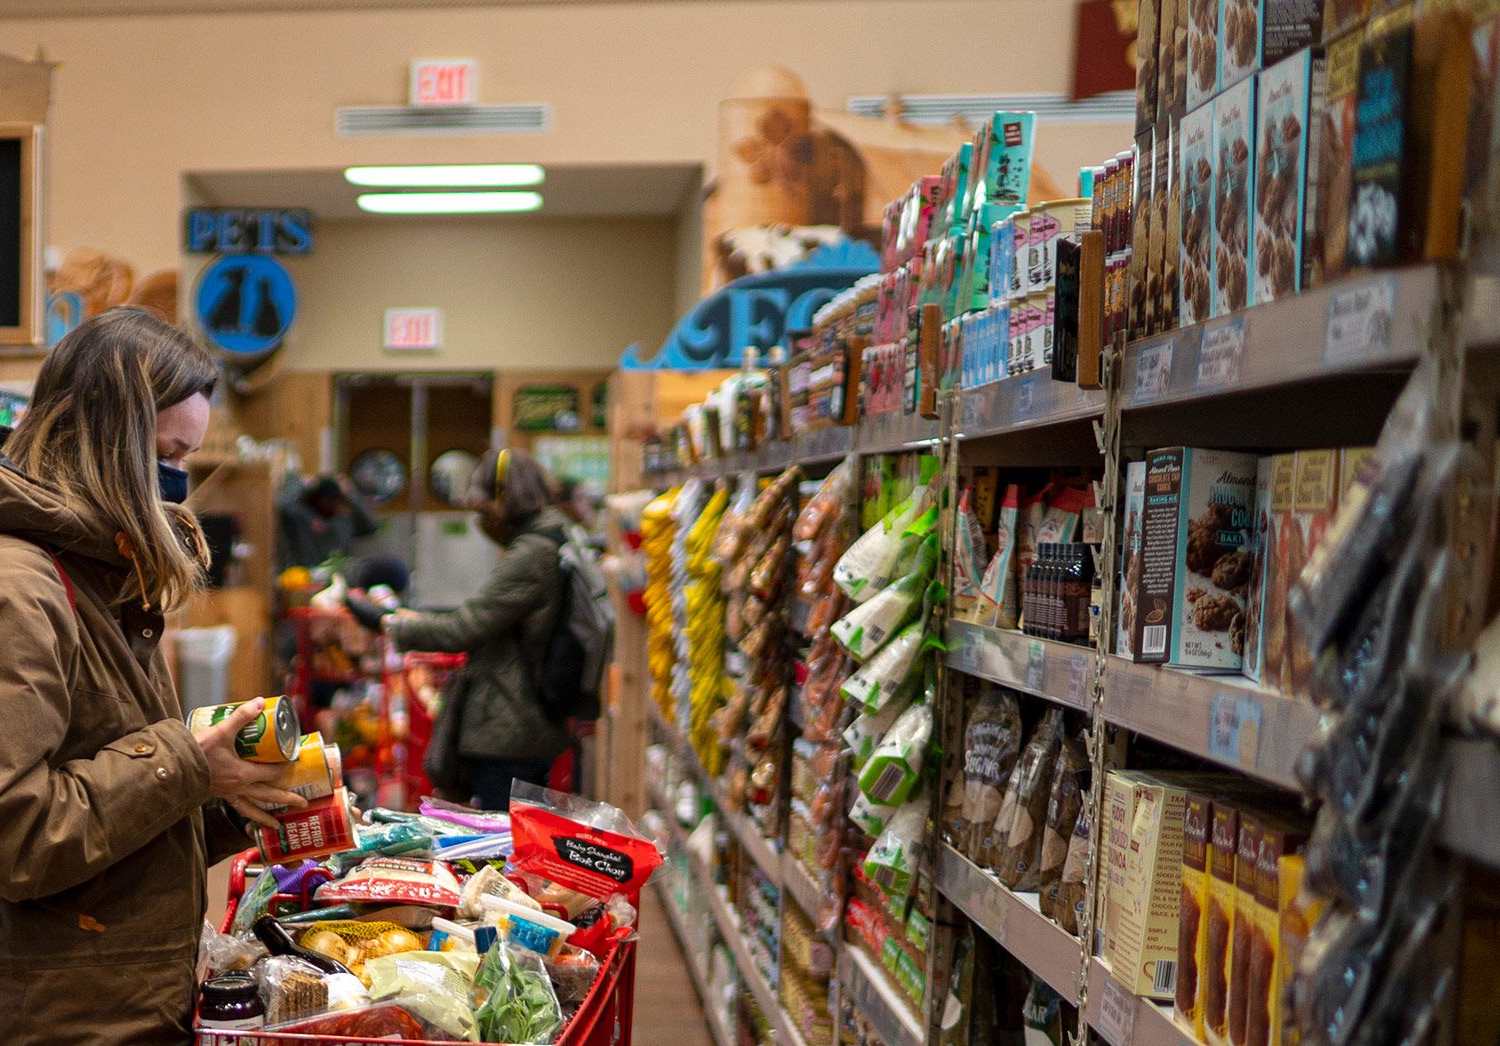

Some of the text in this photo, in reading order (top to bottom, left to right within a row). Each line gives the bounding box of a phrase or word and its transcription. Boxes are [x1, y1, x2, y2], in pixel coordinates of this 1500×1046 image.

[417, 65, 466, 101] EXIT
[189, 210, 313, 252] PETS
[286, 822, 301, 850] BEANS
[298, 822, 312, 847] PINTO
[308, 815, 324, 848] REFRIED
[565, 839, 587, 853] Baby
[569, 850, 594, 867] Bok
[594, 860, 625, 880] Choy
